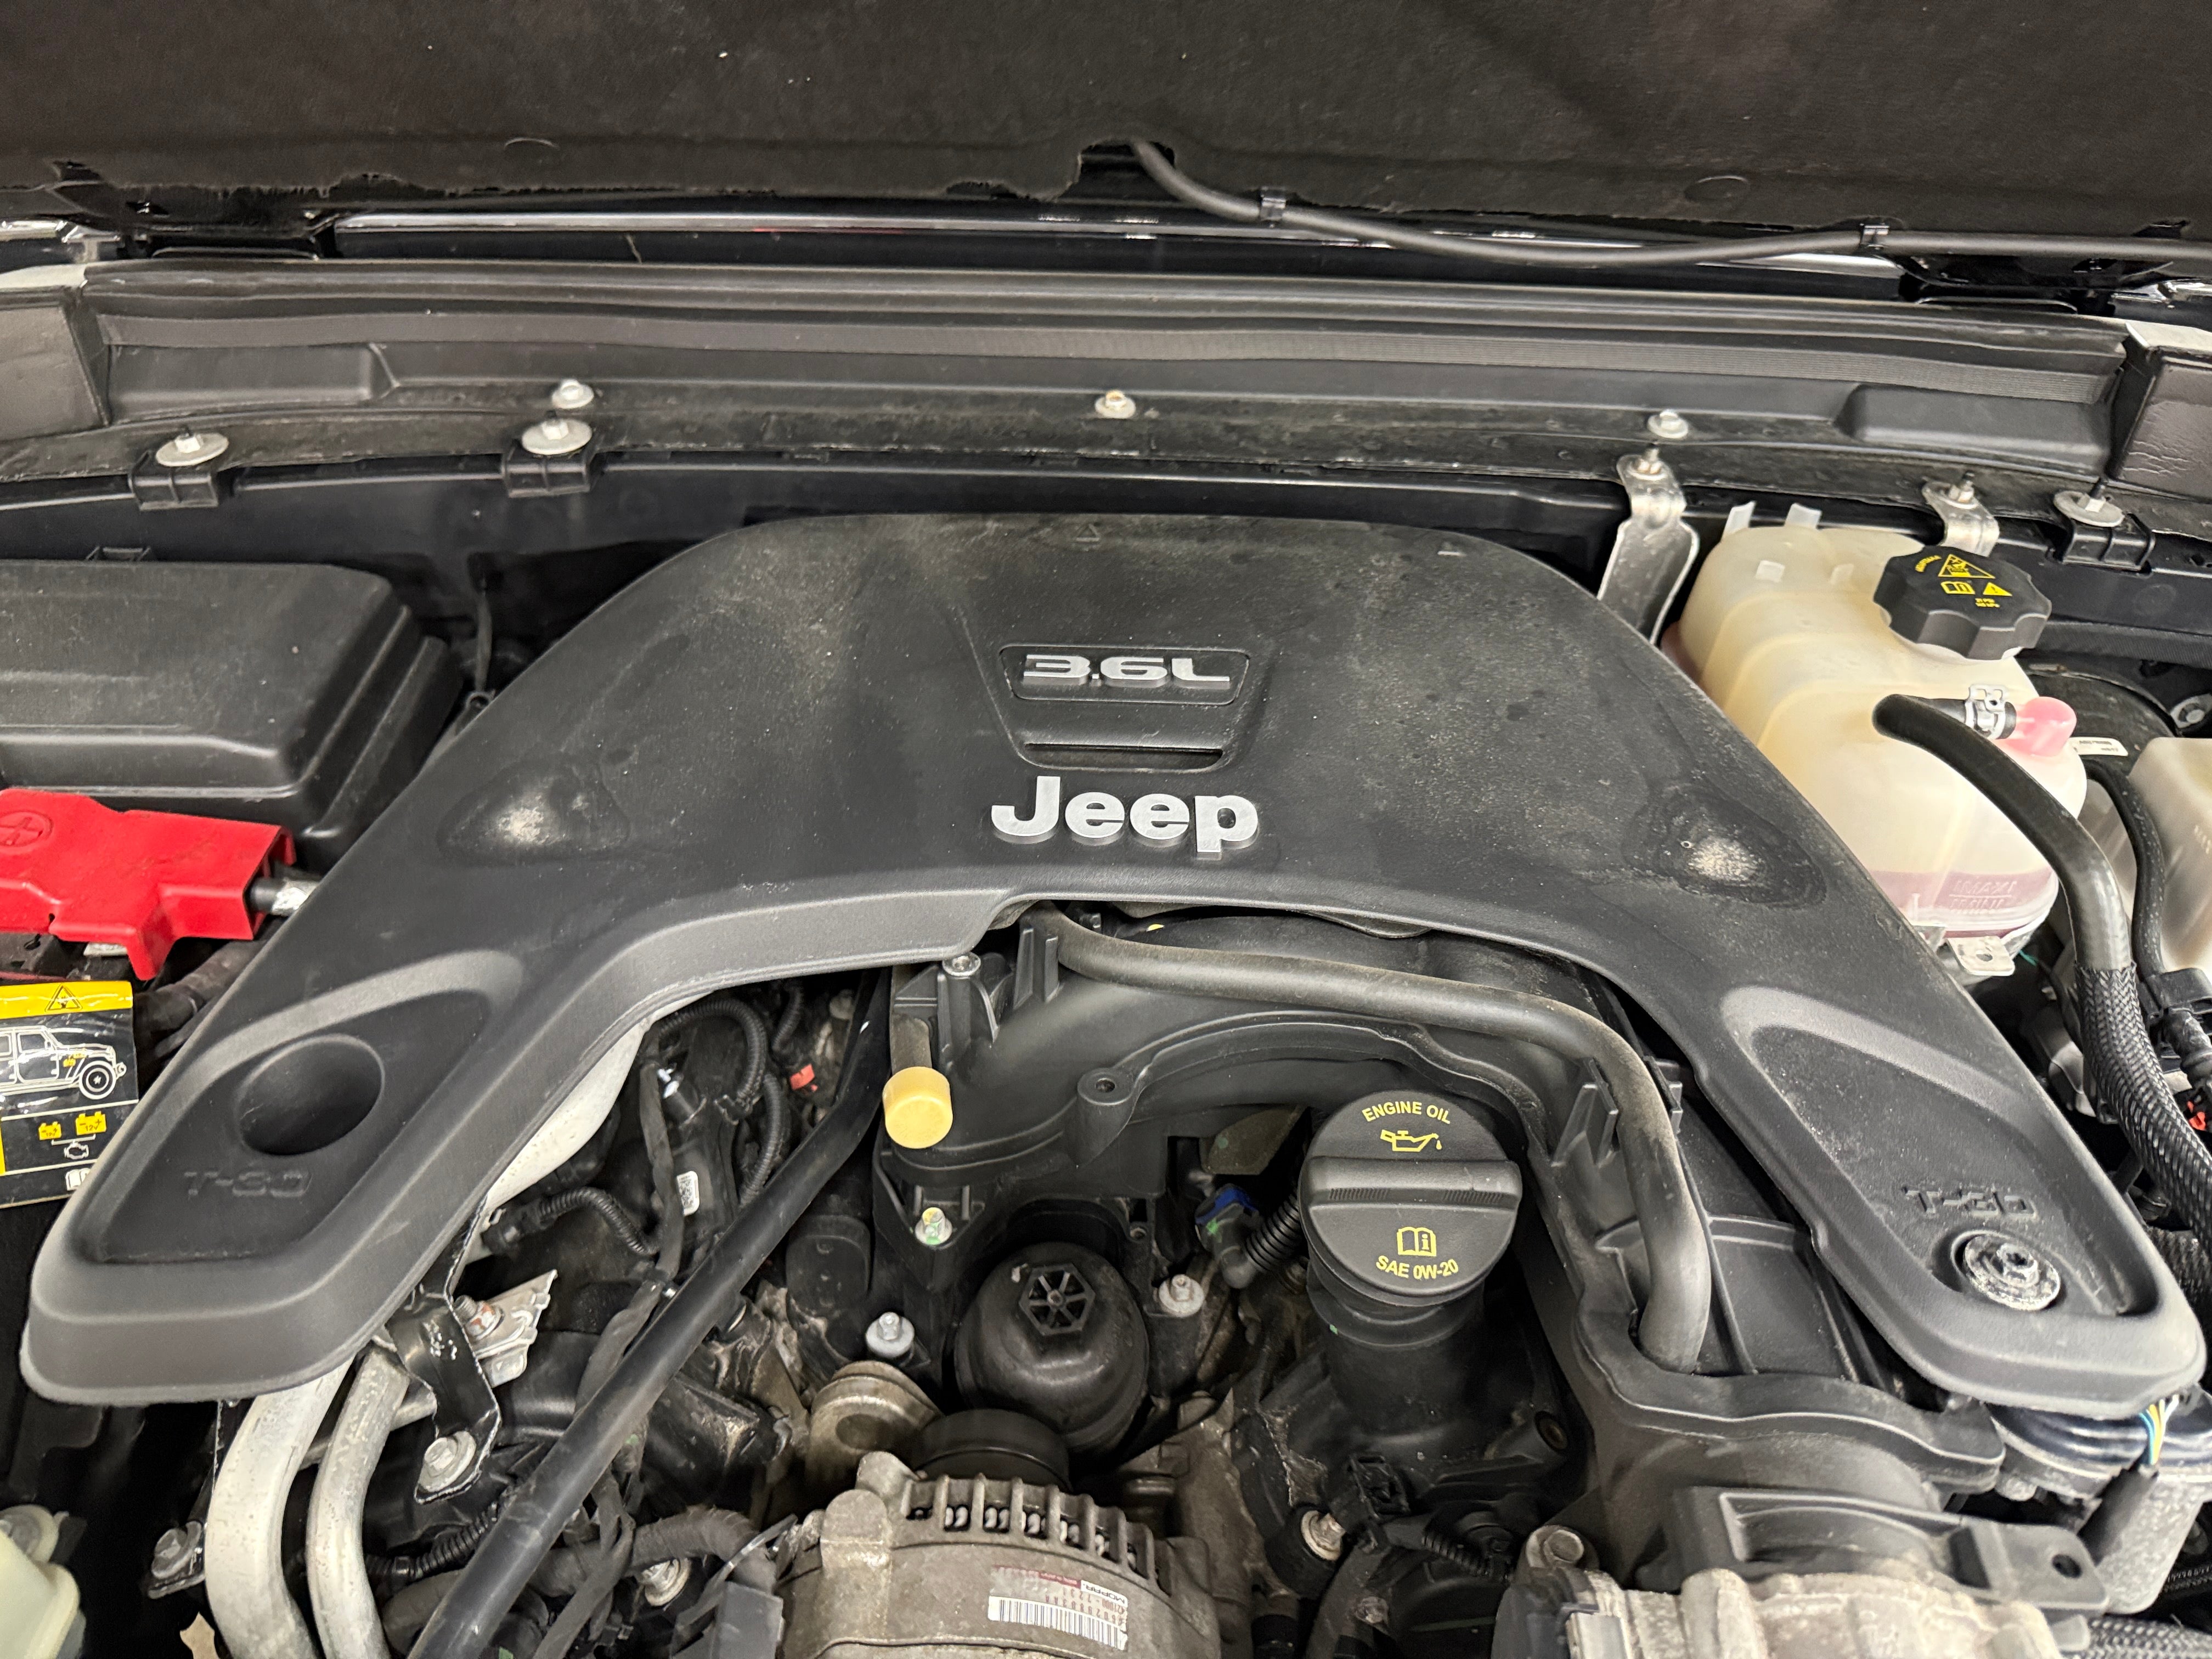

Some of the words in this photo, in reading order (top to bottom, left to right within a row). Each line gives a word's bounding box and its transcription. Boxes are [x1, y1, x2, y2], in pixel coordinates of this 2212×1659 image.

[1022, 654, 1231, 686] 3.6L
[991, 775, 1259, 857] Jeep
[1362, 1101, 1423, 1122] ENGINE
[1426, 1105, 1451, 1124] OIL
[1376, 1255, 1409, 1278] SAE
[1413, 1259, 1459, 1279] 0W-20
